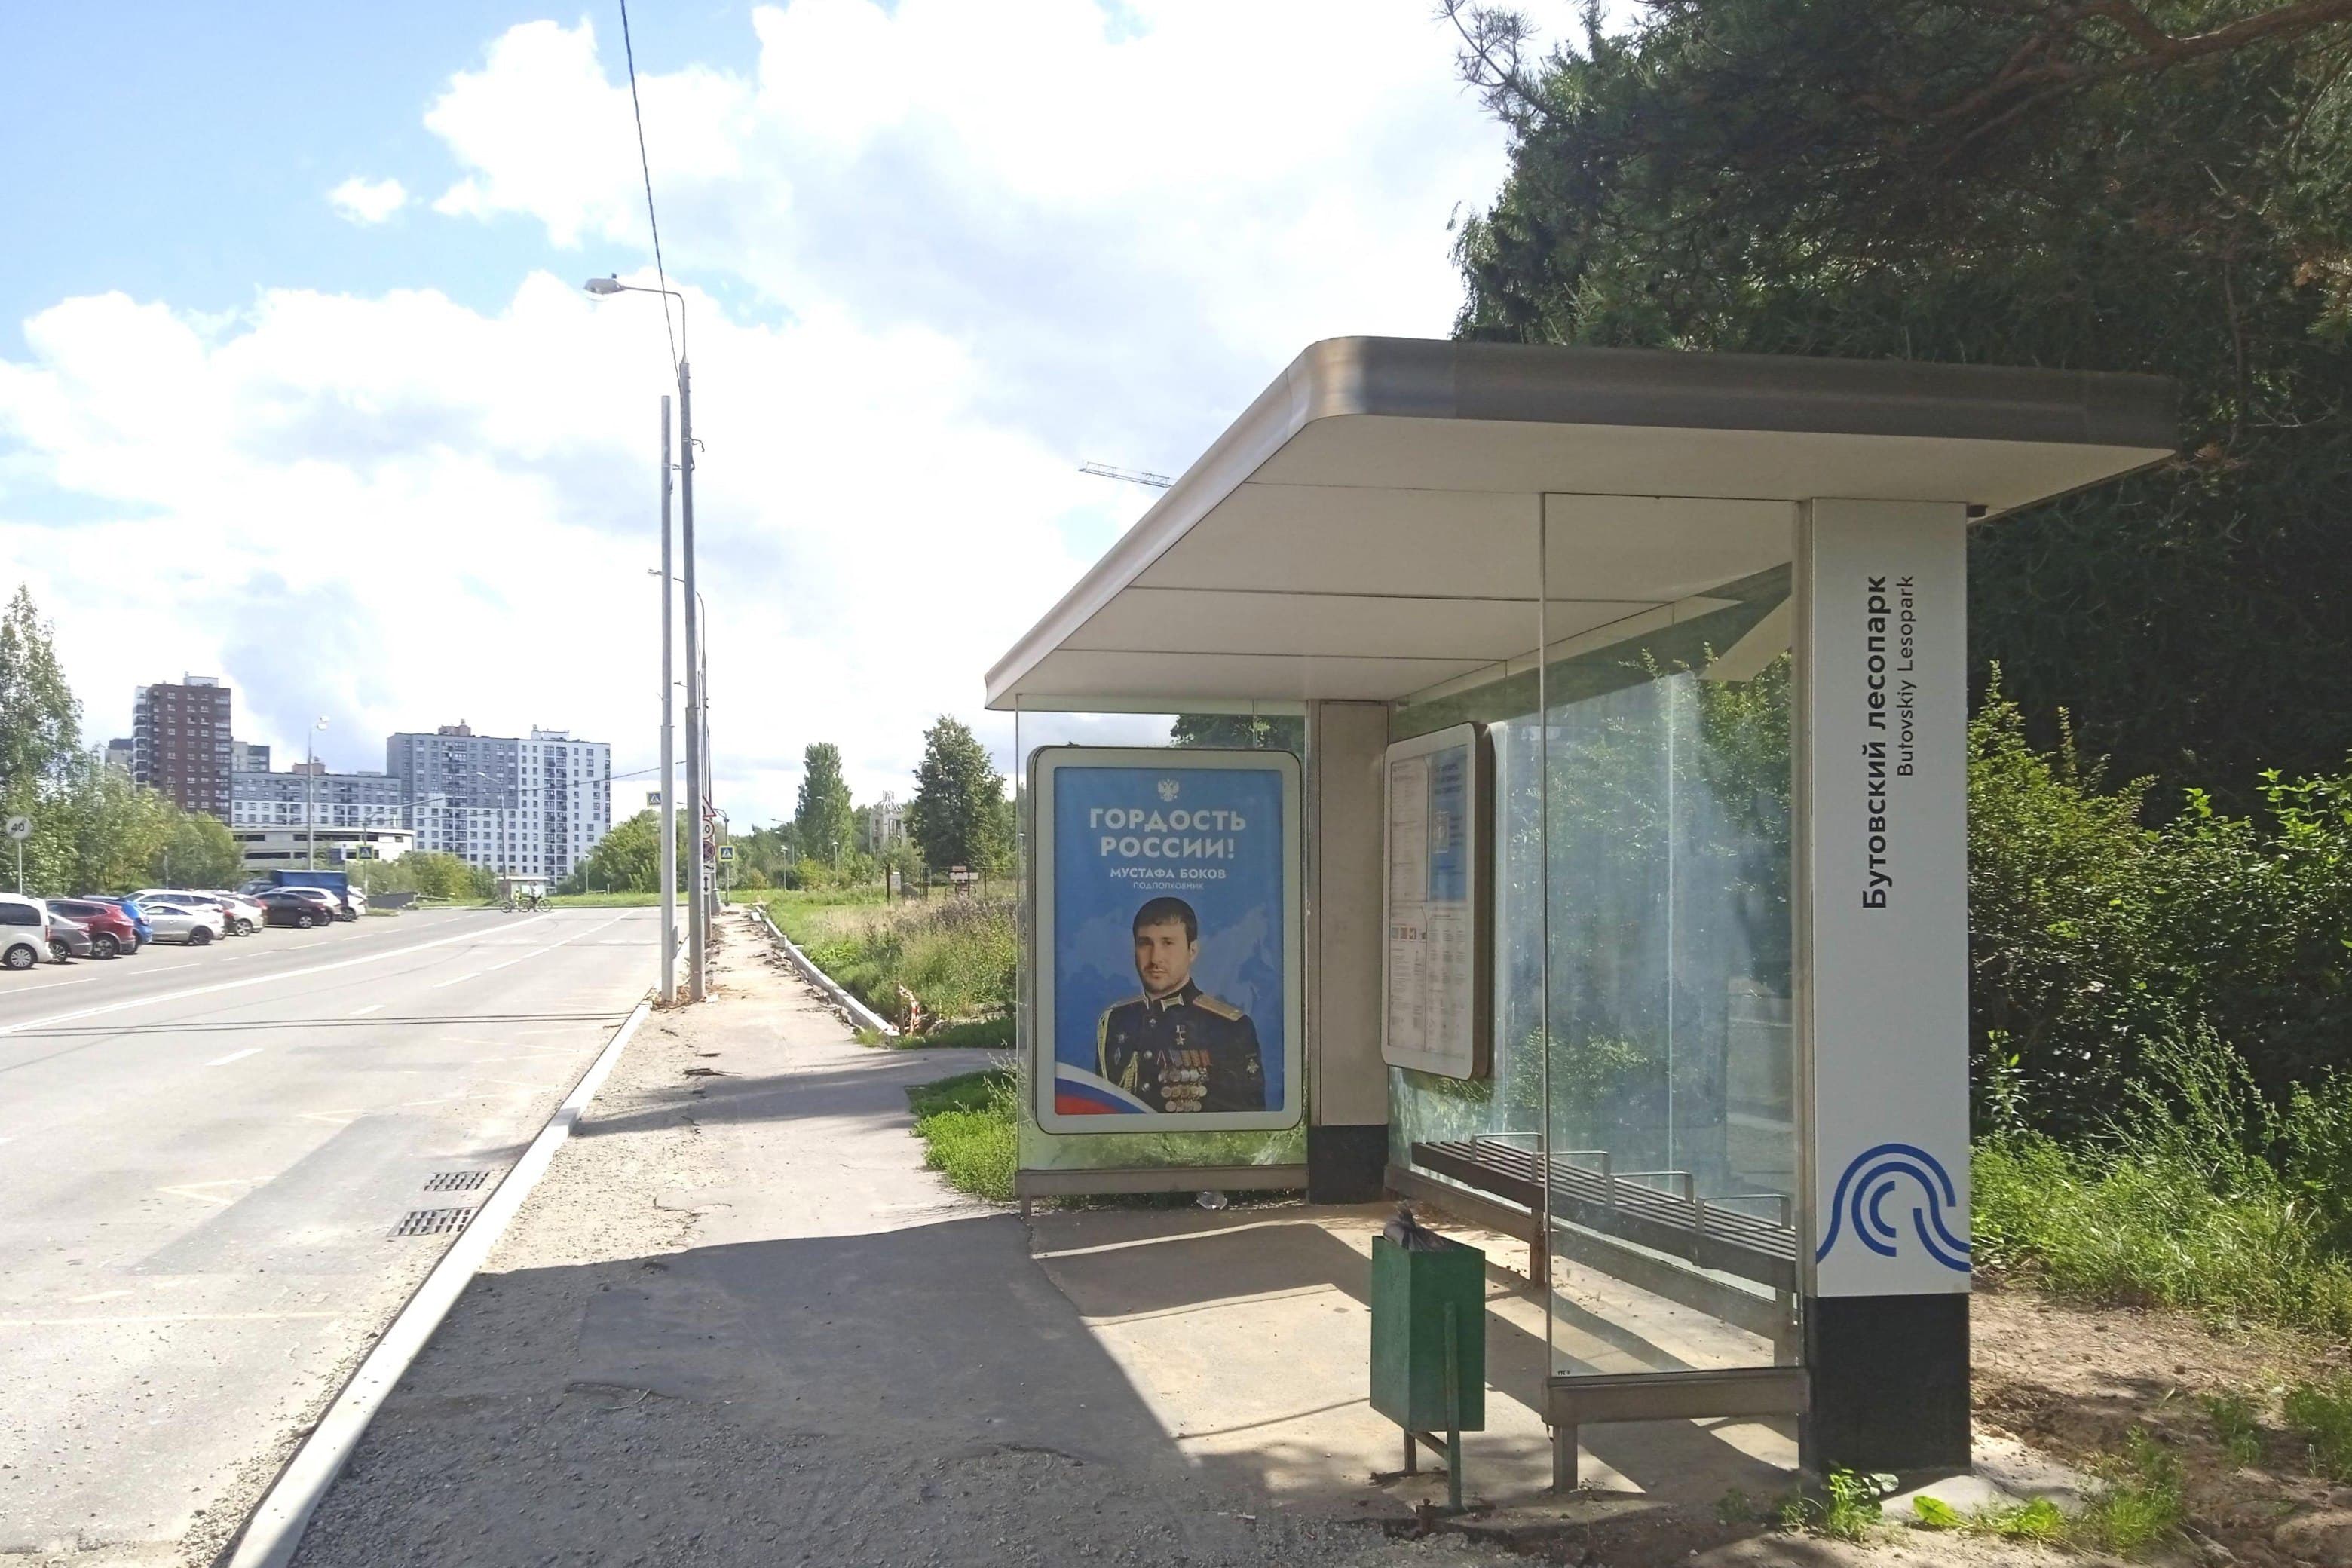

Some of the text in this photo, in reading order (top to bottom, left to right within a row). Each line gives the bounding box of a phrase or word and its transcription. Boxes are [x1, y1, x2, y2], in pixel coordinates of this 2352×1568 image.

[1897, 575, 1917, 776] Butovskiy Lesopark
[1862, 576, 1892, 908] Бутовский лесопарк
[11, 823, 25, 831] 40
[1090, 808, 1246, 832] ГОРДОСТЬ
[1101, 836, 1234, 859] РОССИИ!
[1110, 868, 1227, 879] МУСТАФА БОКОВ
